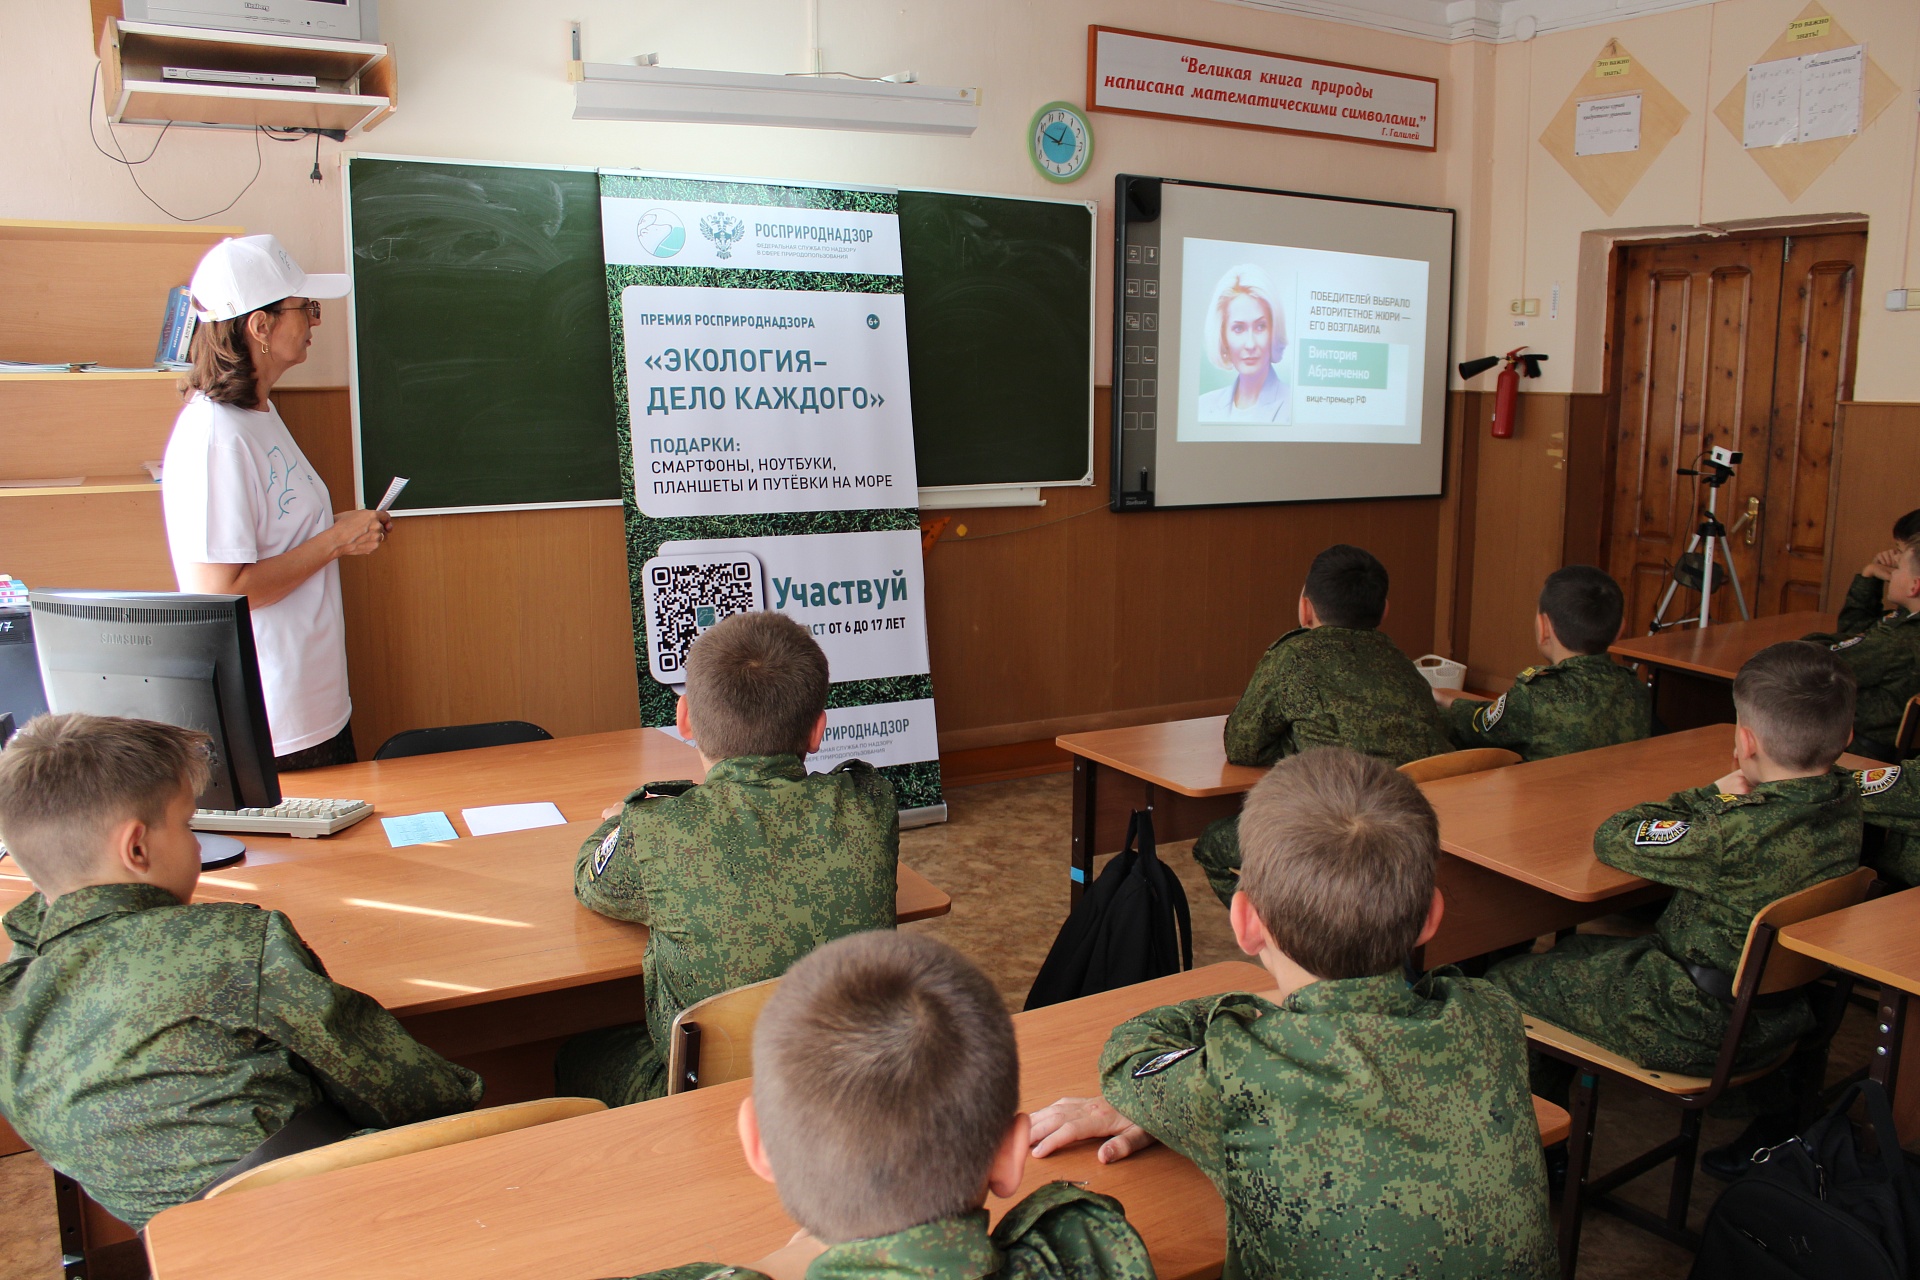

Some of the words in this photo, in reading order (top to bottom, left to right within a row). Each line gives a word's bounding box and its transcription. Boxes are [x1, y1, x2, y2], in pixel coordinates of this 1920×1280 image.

[1259, 68, 1303, 88] книга
[1311, 80, 1373, 98] природы
[1104, 74, 1185, 97] написана
[1190, 84, 1337, 117] математическими
[1389, 128, 1420, 140] Галилей
[755, 223, 873, 244] РОСПРИРОДНАДЗОР
[756, 242, 797, 250] ФЕДЕРАЛЬНАЯ
[781, 251, 849, 259] ПРИРОДОПОЛЬЗОВАНИЯ
[1310, 290, 1371, 305] ПОБЕДИТЕЛЕЙ
[1372, 296, 1411, 308] ВЫБРАЛО
[640, 313, 692, 326] ПРЕМИЯ
[694, 314, 816, 330] РОСПРИРОДНАДЗОРА
[868, 317, 879, 327] 6+
[1310, 306, 1374, 320] АВТОРИТЕТНОЕ
[1375, 311, 1400, 322] ЖЮРИ
[1309, 321, 1326, 331] ЕГО
[1327, 322, 1381, 335] ВОЗГЛАВИЛА
[1308, 346, 1358, 364] Виктория
[1308, 364, 1370, 381] Абрамченко
[646, 386, 727, 416] ДЕЛО
[735, 386, 886, 415] КАЖДОГО»
[1306, 395, 1355, 405] вице-премьер
[1355, 395, 1367, 404] РФ
[650, 436, 741, 456] ПОДАРКИ:
[651, 459, 755, 475] СМАРТФОНЫ,
[758, 457, 837, 473] НОУТБУКИ,
[653, 477, 744, 495] ПЛАНШЕТЫ
[748, 478, 759, 491] И
[762, 473, 829, 491] ПУТЁВКИ
[832, 476, 852, 489] НА
[854, 474, 893, 488] МОРЕ
[772, 569, 908, 610] Участвуй
[829, 622, 842, 634] ОТ
[845, 621, 851, 633] 6
[853, 620, 868, 634] ДО
[871, 619, 883, 631] 17
[885, 617, 906, 630] ЛЕТ
[101, 633, 153, 646] SAMSUNG
[821, 718, 910, 742] РИРОДНАДЗОР
[820, 747, 886, 760] ПРИРОДОПОЛЬЗОВАНИЯ
[835, 744, 859, 752] СЛУЖБА
[868, 740, 893, 748] НАДЗОРУ
